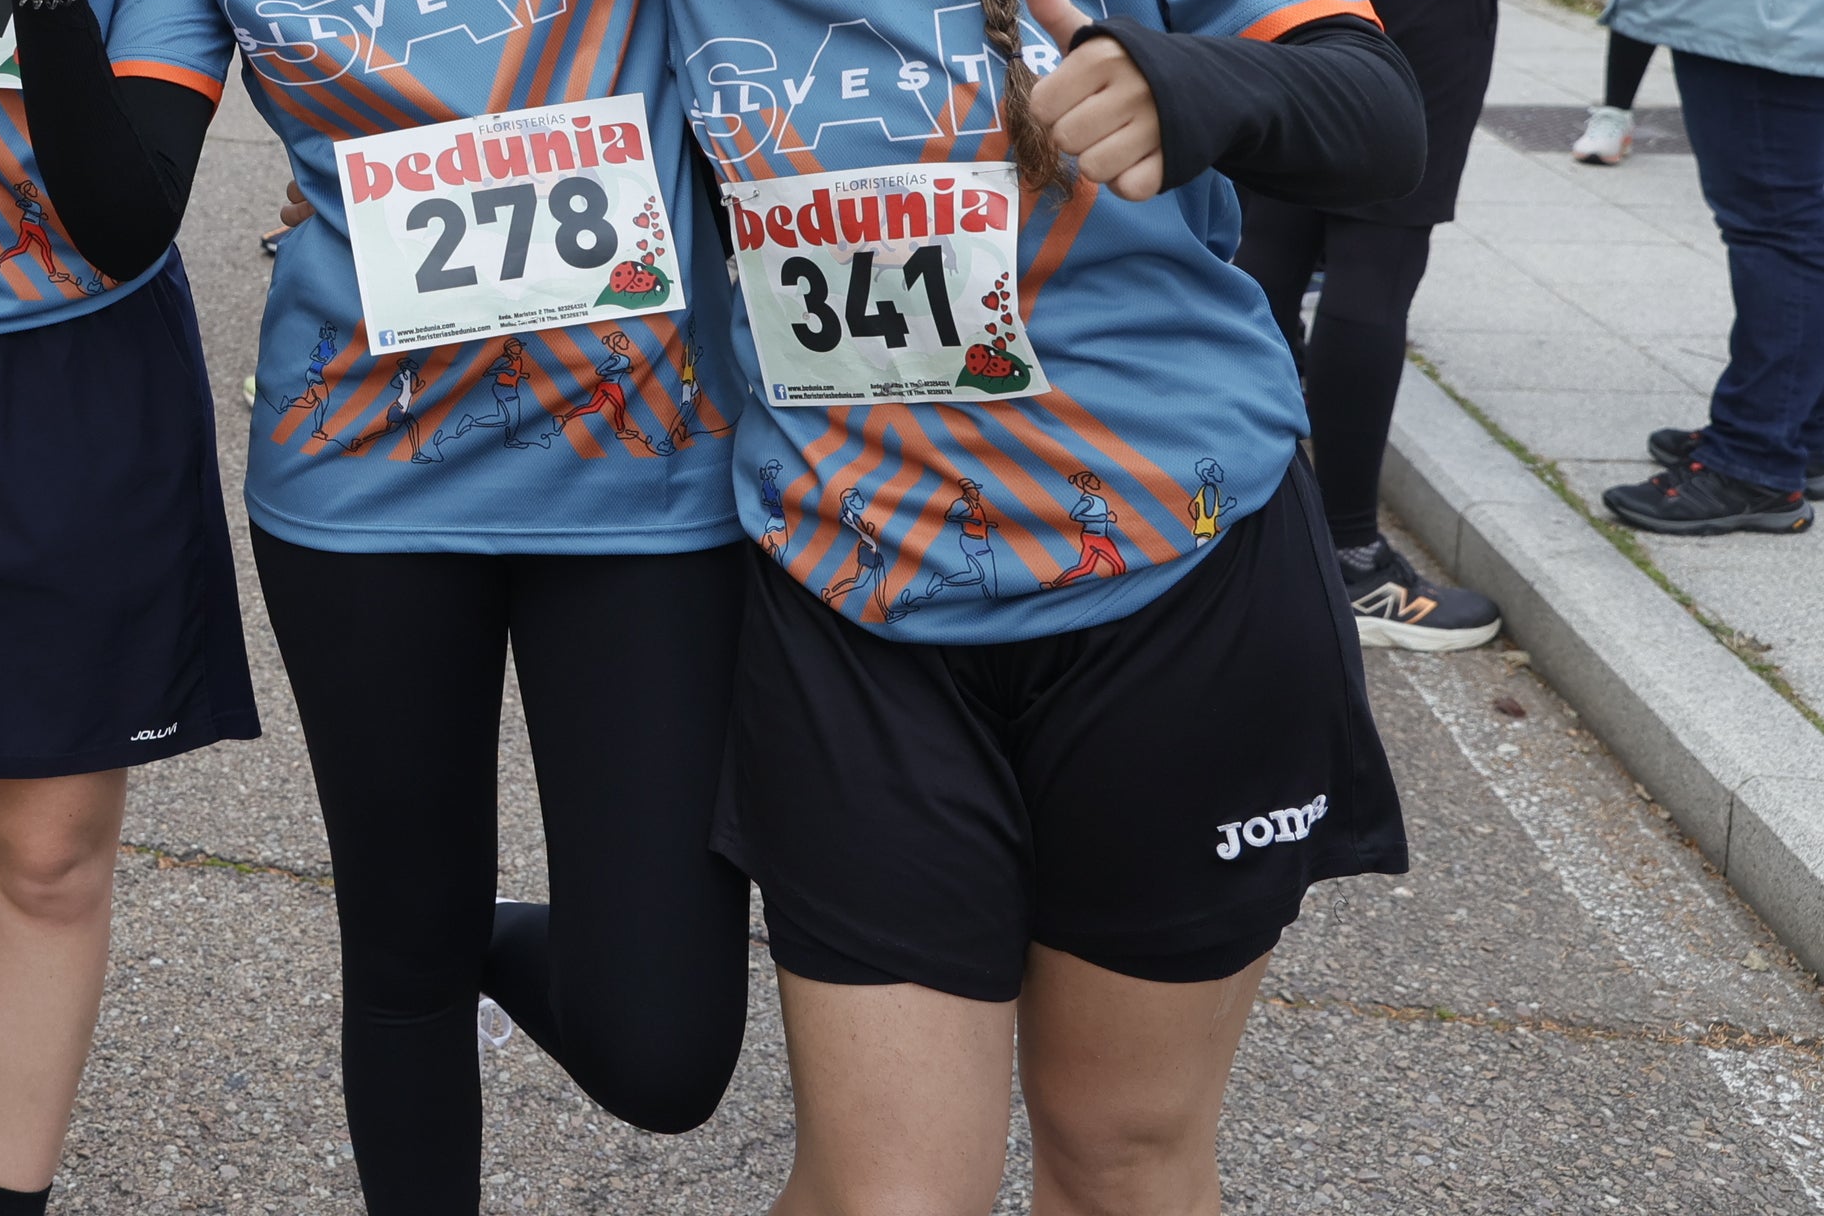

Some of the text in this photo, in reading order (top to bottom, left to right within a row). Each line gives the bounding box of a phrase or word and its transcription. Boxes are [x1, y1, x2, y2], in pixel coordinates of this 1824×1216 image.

[478, 112, 566, 135] FLORISTERÍAS
[344, 114, 645, 204] bedunia
[834, 172, 927, 192] FLORISTERÍAS
[405, 176, 619, 294] 278
[732, 178, 1009, 251] bedunia
[780, 245, 962, 353] 341
[397, 322, 456, 337] www.bedunia.com
[398, 324, 491, 344] www.floristeriasbedunia.com
